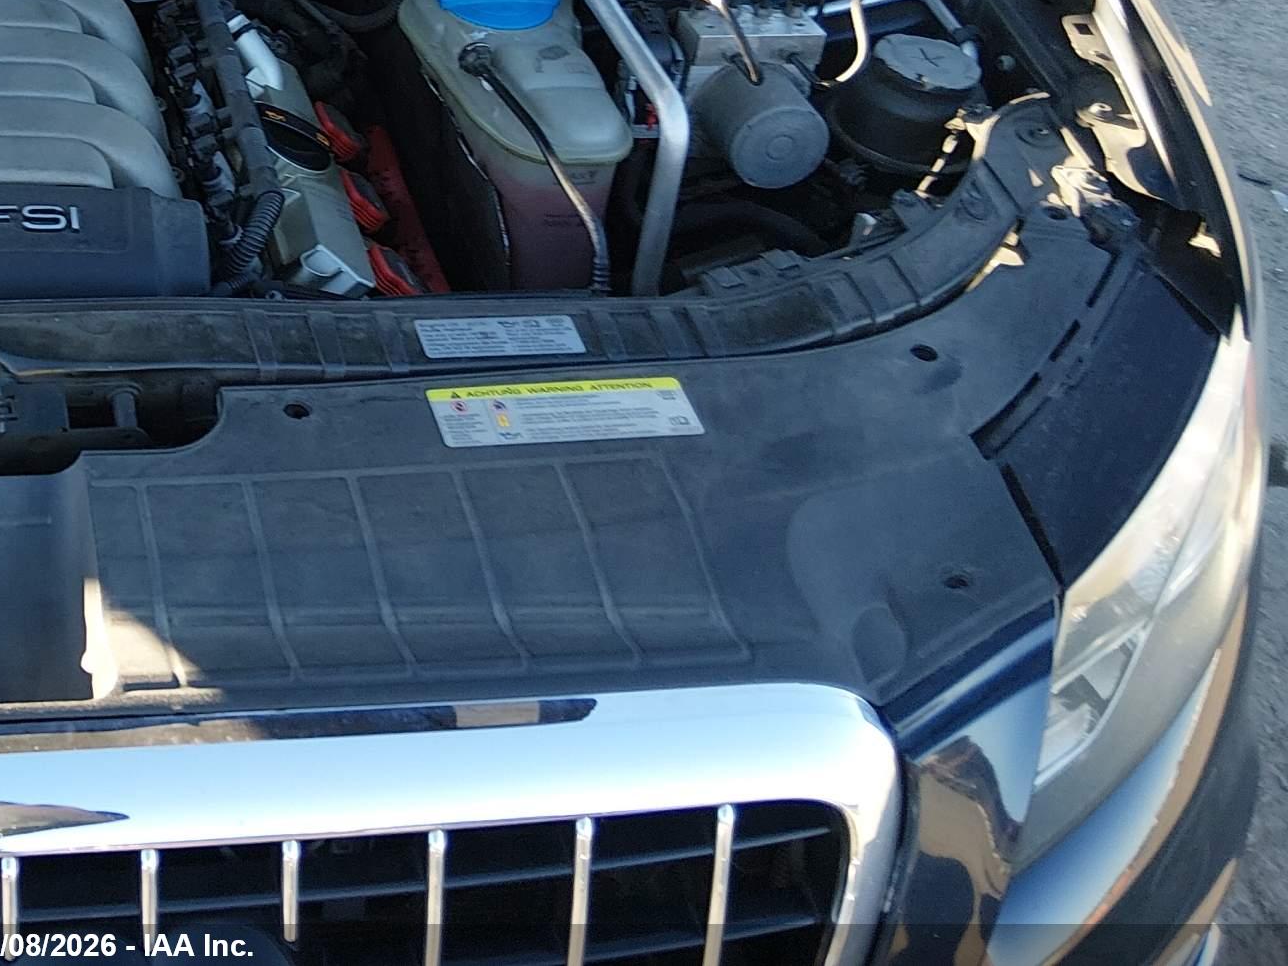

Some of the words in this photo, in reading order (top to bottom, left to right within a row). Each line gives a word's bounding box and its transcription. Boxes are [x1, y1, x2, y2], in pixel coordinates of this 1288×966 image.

[465, 387, 521, 399] ACHTUNG
[526, 385, 584, 394] WARNING
[590, 381, 654, 392] ATTENTION
